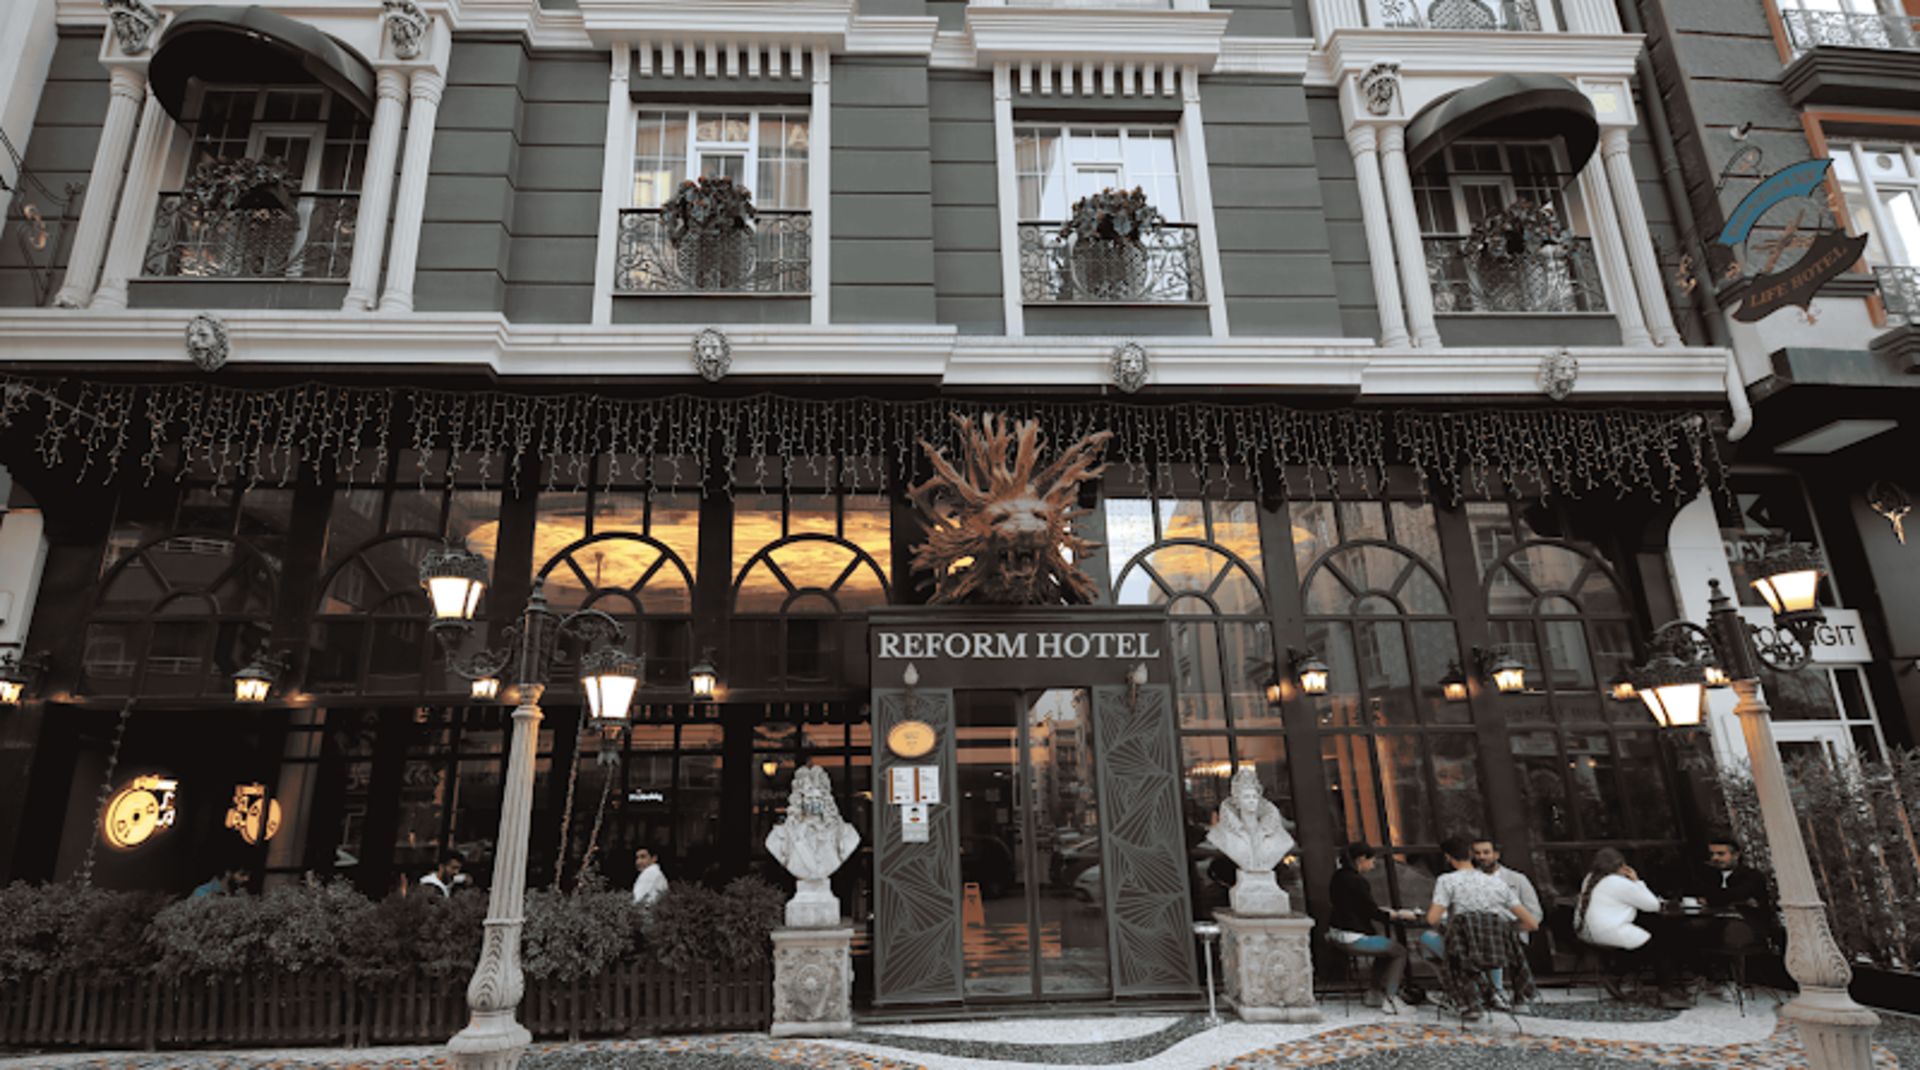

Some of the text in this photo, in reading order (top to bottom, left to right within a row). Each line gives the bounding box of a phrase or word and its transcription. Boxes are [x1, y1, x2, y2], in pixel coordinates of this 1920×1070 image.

[1750, 247, 1848, 308] LIFE HOTEL
[878, 632, 1160, 658] REFORM HOTEL
